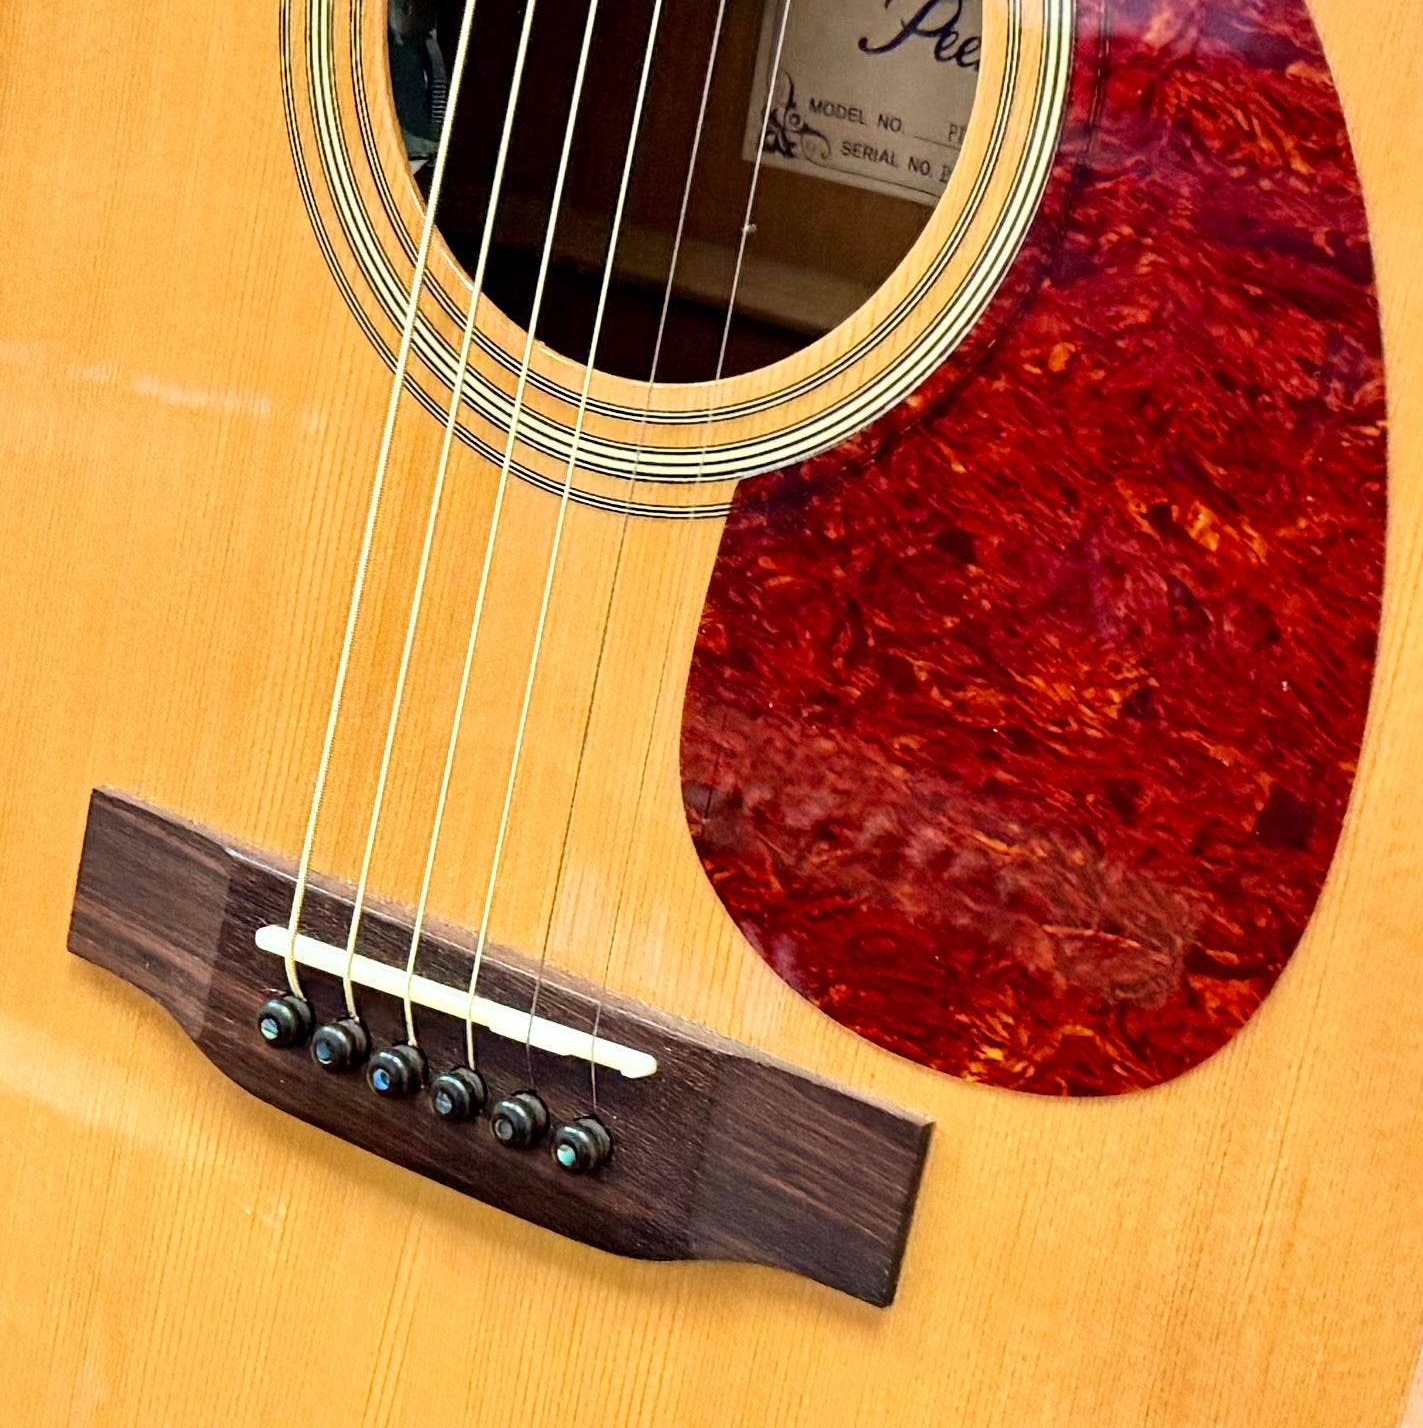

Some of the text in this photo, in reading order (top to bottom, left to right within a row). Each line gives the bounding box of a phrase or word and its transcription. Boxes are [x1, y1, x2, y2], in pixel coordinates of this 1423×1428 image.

[808, 97, 867, 126] MODEL
[877, 113, 906, 135] NO.
[841, 140, 899, 169] SERIAL
